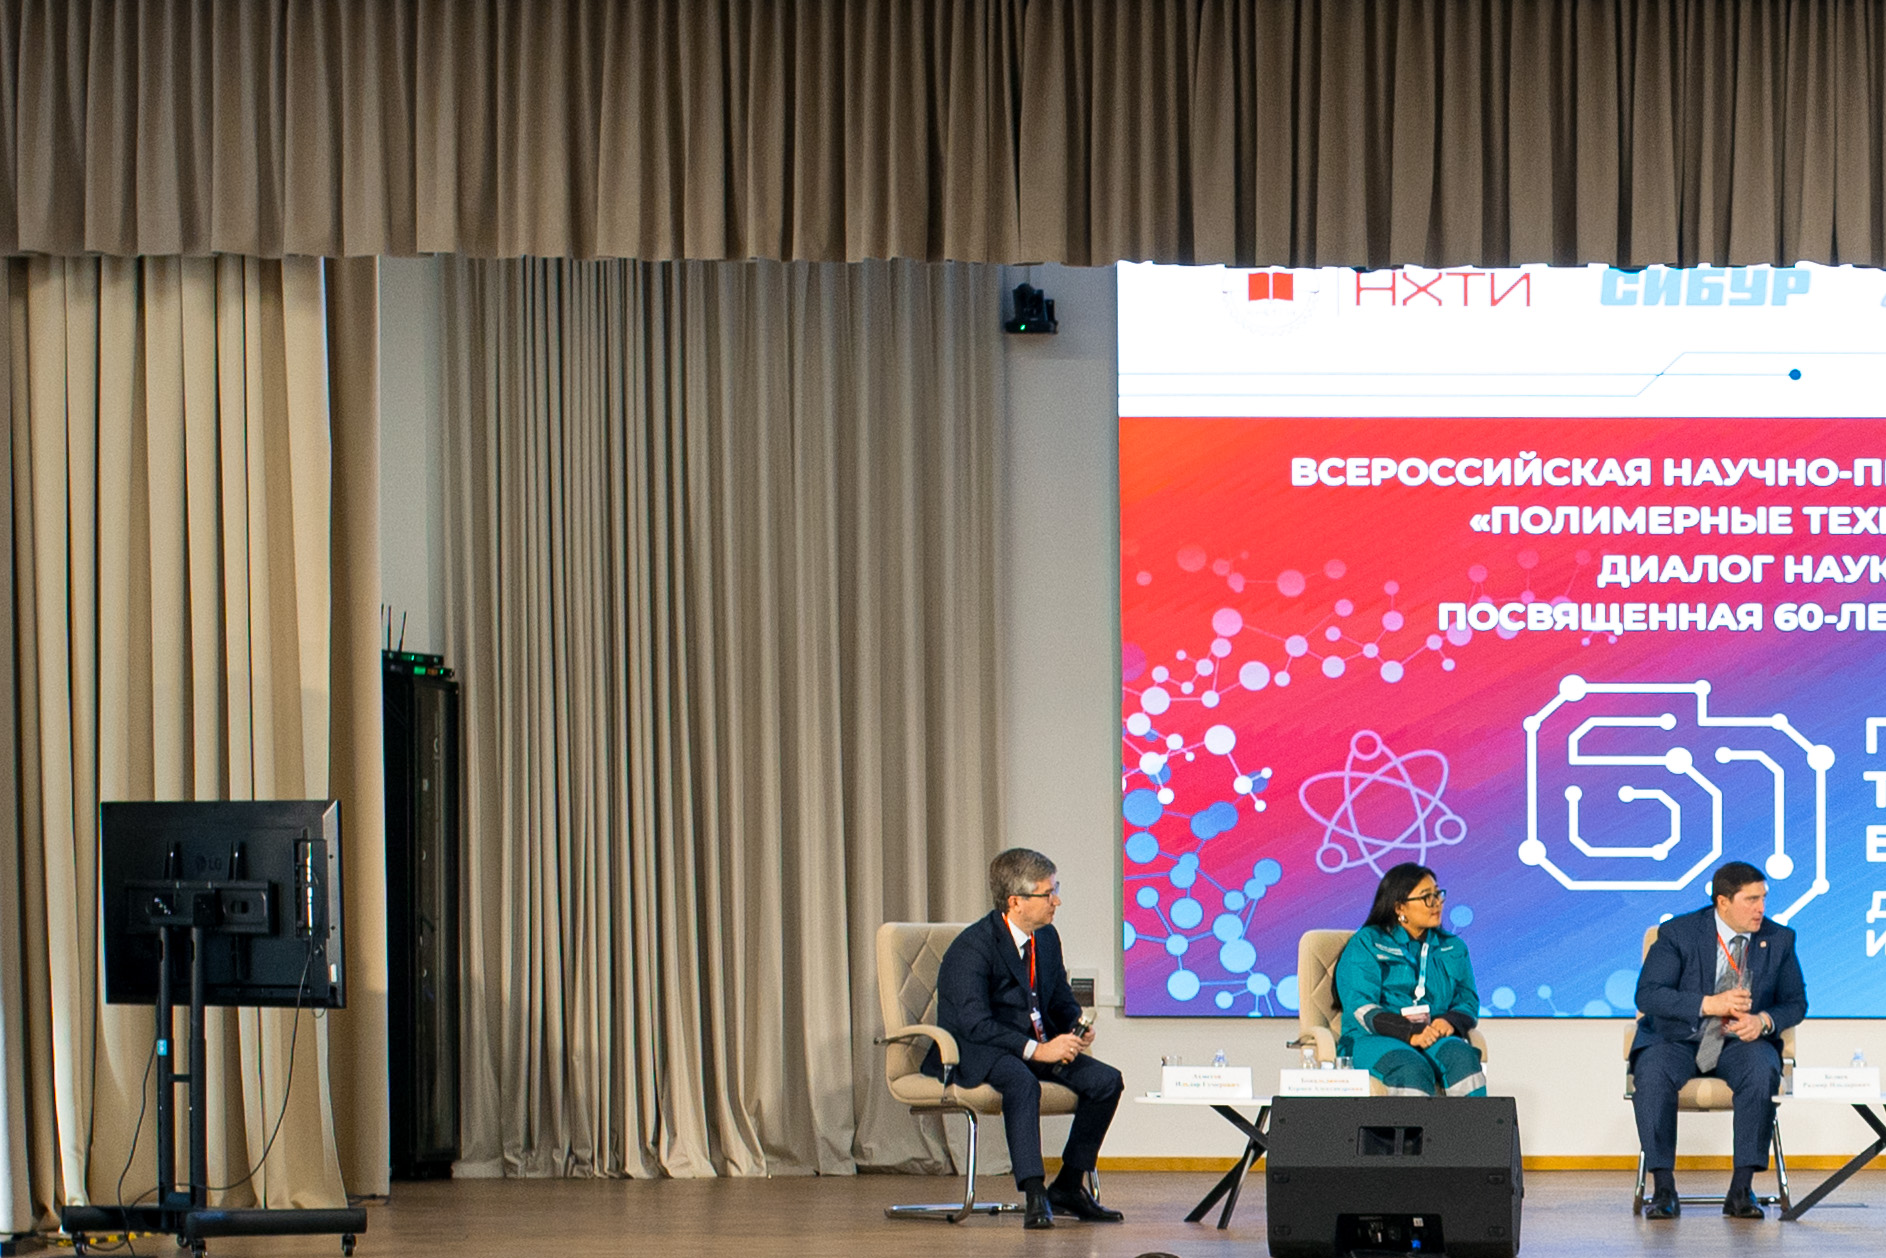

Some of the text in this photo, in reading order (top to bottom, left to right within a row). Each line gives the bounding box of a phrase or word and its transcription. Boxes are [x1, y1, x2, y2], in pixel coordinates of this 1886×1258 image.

[1355, 271, 1531, 307] НХТИ
[1600, 268, 1812, 307] СИБУР
[1291, 451, 1652, 487] ВСЕРОССИЙСКАЯ
[1470, 505, 1793, 535] «ПОЛИМЕРНЫЕ
[1597, 555, 1775, 588] ДИАЛОГ
[1438, 602, 1763, 635] ПОСВЯЩЕННАЯ
